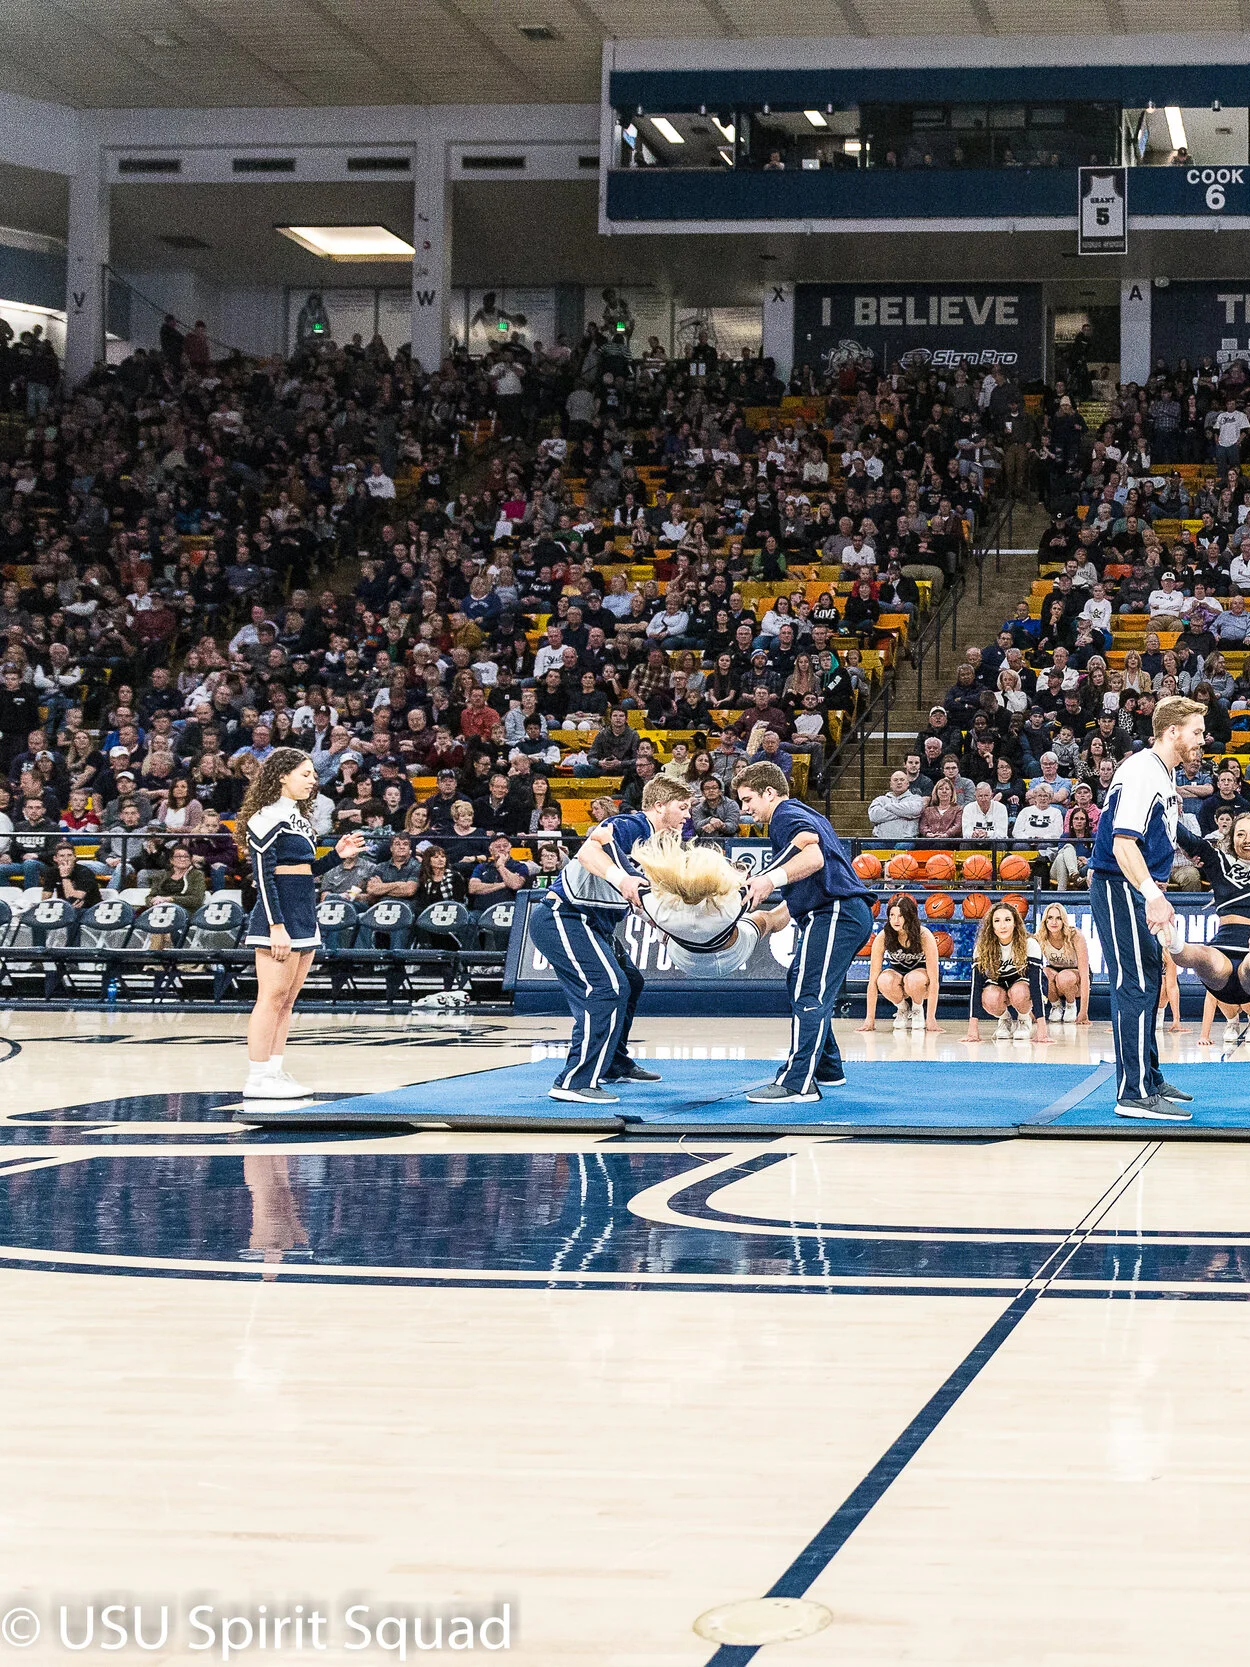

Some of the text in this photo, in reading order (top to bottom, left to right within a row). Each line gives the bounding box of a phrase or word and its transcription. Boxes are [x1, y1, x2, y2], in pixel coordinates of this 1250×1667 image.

[1186, 169, 1244, 184] COOK
[1206, 184, 1226, 210] 6
[1096, 207, 1110, 225] 5
[73, 292, 86, 308] V
[416, 290, 436, 306] W
[772, 286, 785, 302] X
[1128, 285, 1143, 301] A
[821, 296, 1019, 326] I BELIEVE
[931, 350, 979, 369] Sign
[979, 350, 1018, 365] Pro
[814, 608, 837, 619] LOVE
